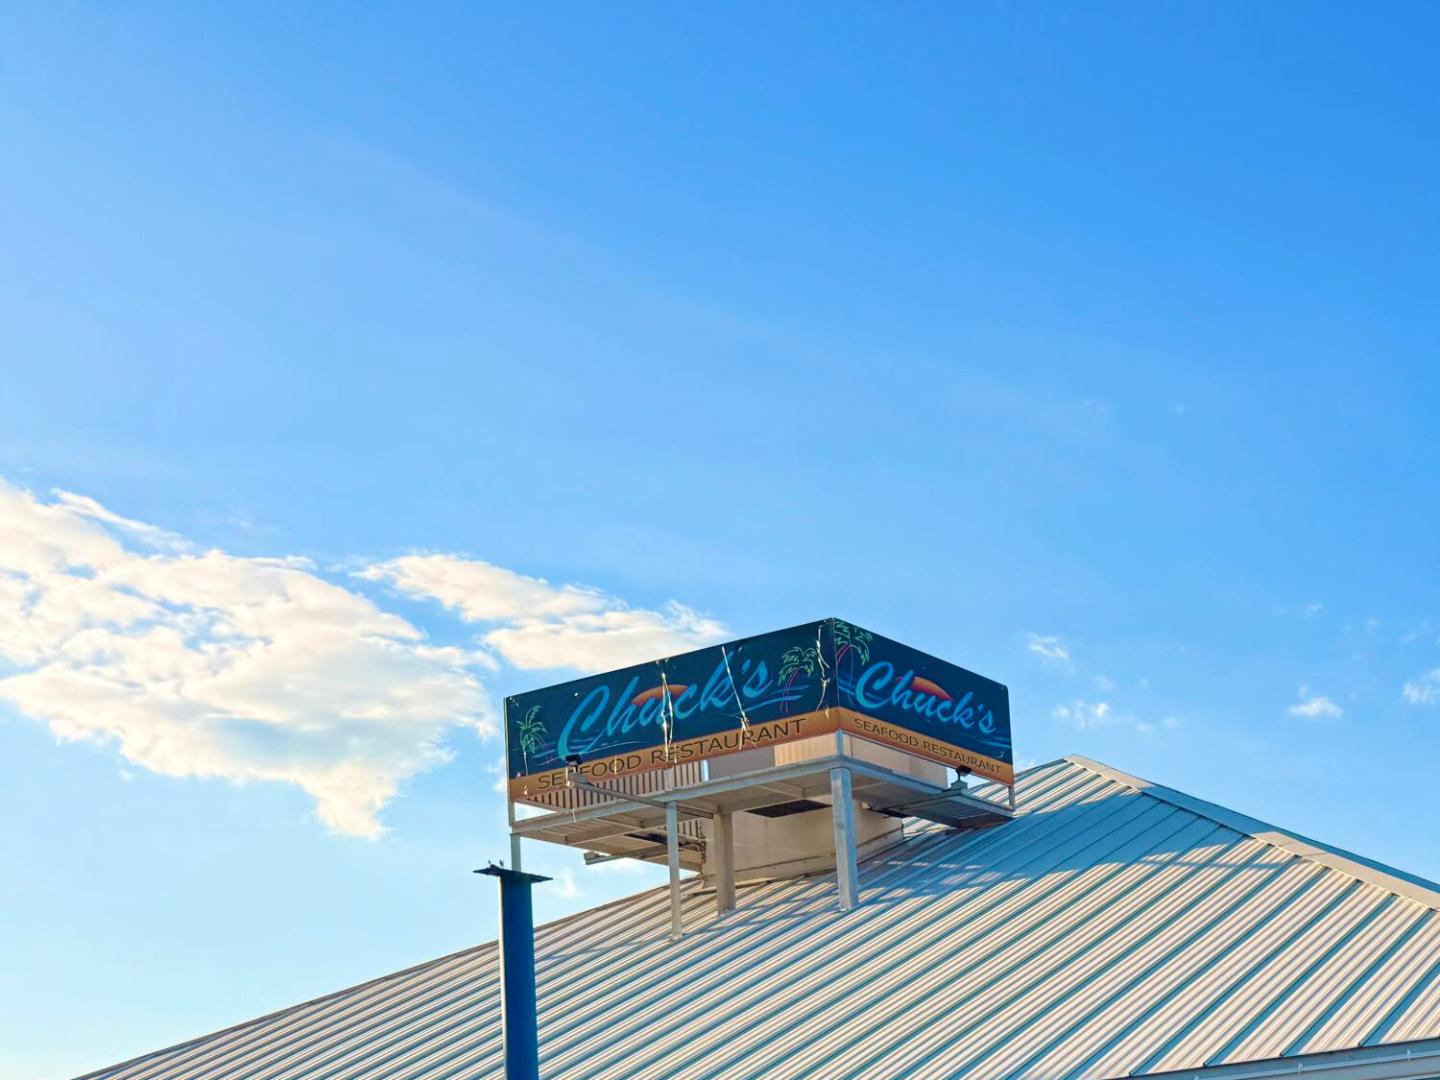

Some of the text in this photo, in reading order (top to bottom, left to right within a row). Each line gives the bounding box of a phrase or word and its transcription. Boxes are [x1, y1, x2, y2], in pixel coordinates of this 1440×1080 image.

[557, 651, 772, 756] Chuck's
[855, 661, 996, 734] Chuck's
[538, 718, 805, 790] SEFOOD RESTAURANT
[854, 718, 1001, 774] SEAFOOD RESTAURANT
